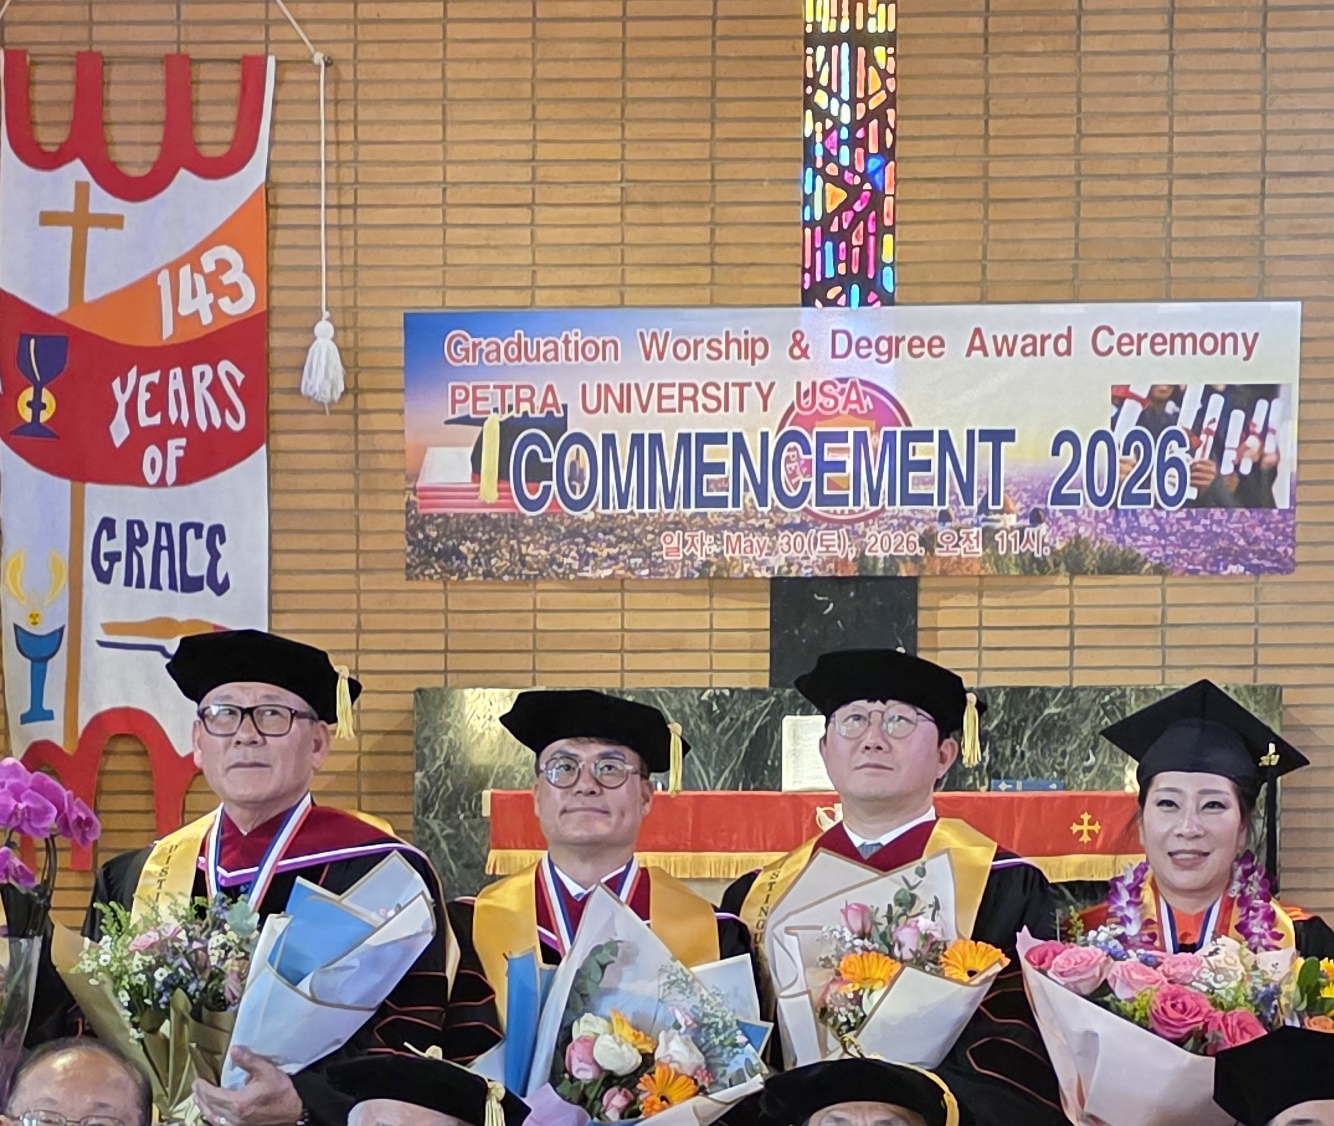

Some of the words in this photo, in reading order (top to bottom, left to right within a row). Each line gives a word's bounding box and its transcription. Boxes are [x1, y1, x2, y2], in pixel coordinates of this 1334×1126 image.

[156, 244, 256, 341] 143
[445, 331, 621, 364] Graduation
[638, 329, 770, 367] Worship
[788, 328, 811, 361] &
[830, 328, 946, 365] Degree
[965, 325, 1073, 358] Award
[1091, 324, 1260, 362] Ceremony
[108, 359, 246, 449] YEARS
[450, 383, 564, 416] PETRA
[580, 380, 777, 415] UNIVERSITY
[795, 379, 865, 414] USA
[141, 436, 188, 485] OF
[512, 428, 1016, 513] COMMENCEMENT
[1049, 428, 1189, 508] 2026
[90, 515, 231, 597] GRACE
[661, 531, 714, 560] 일자:
[725, 533, 767, 558] May
[866, 532, 925, 555] 2026.
[936, 529, 983, 556] 오전
